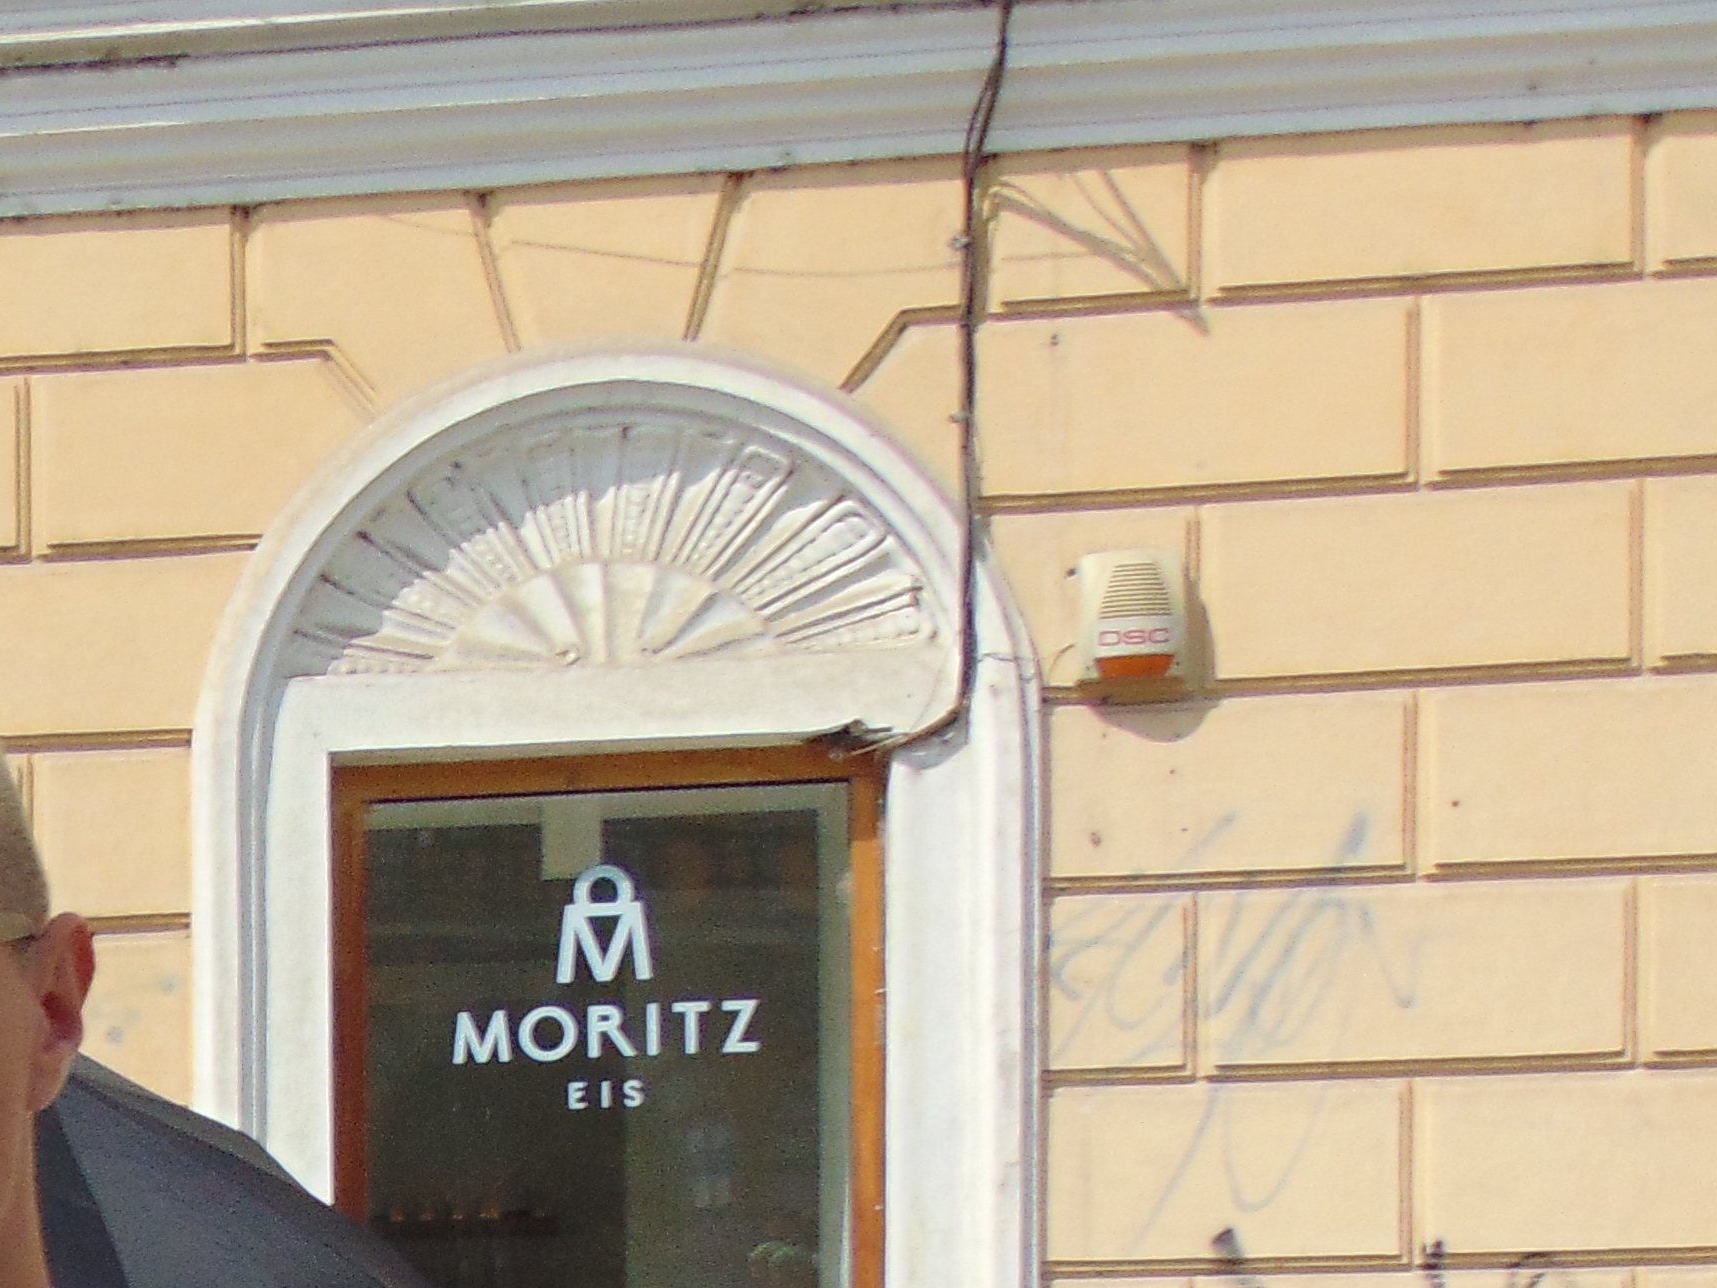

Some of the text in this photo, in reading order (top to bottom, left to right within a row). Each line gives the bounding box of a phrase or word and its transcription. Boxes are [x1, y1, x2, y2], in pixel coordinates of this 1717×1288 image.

[1098, 627, 1170, 646] DSC
[452, 999, 762, 1066] MORITZ
[566, 1080, 646, 1110] EIS
